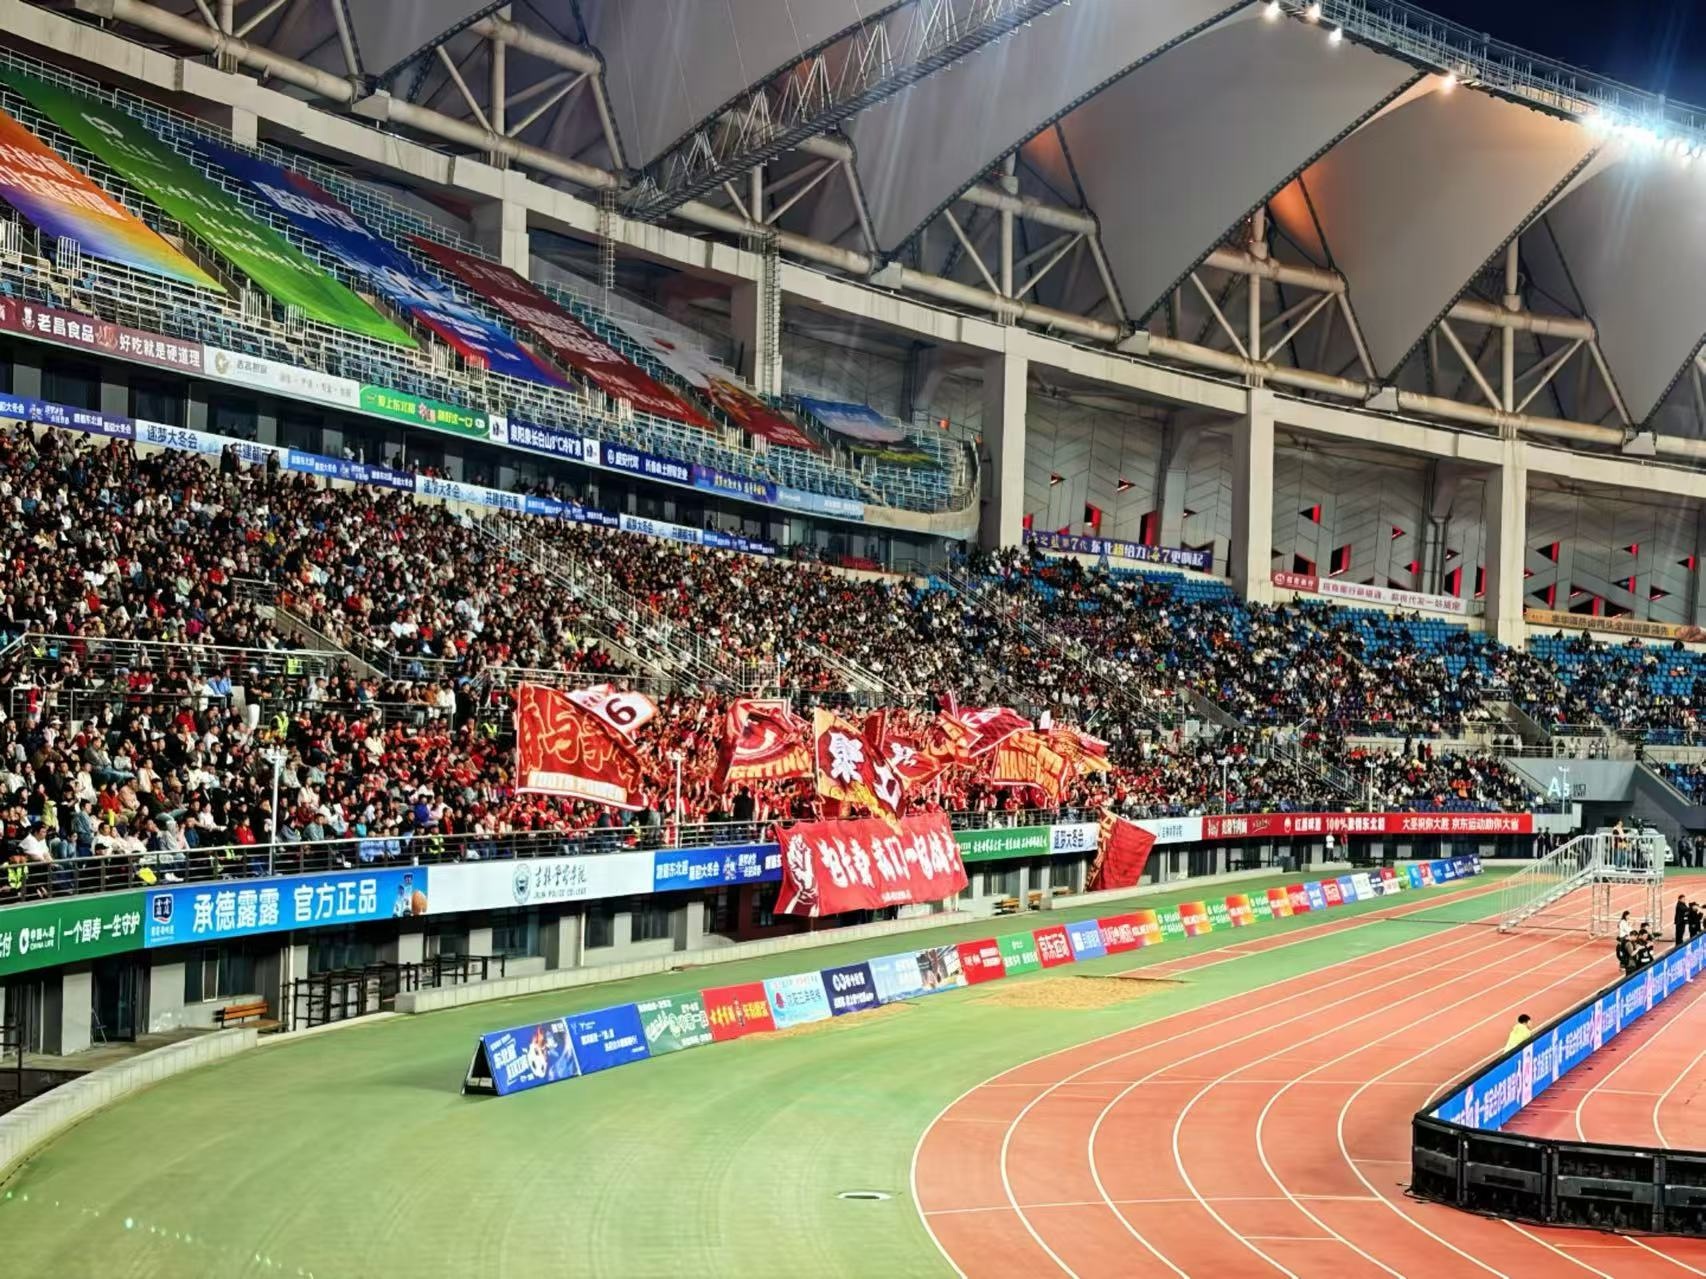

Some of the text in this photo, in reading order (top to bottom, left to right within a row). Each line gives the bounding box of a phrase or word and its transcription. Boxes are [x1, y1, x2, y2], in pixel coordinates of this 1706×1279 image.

[37, 313, 95, 343] 老昌食品
[119, 333, 200, 367] 好吃就是硬道理
[147, 425, 198, 449] 逐梦大冬会
[605, 697, 637, 725] 6
[193, 878, 378, 933] 承德露露 官方正品
[64, 917, 102, 945] 一个国寿
[103, 911, 140, 938] 一生守护
